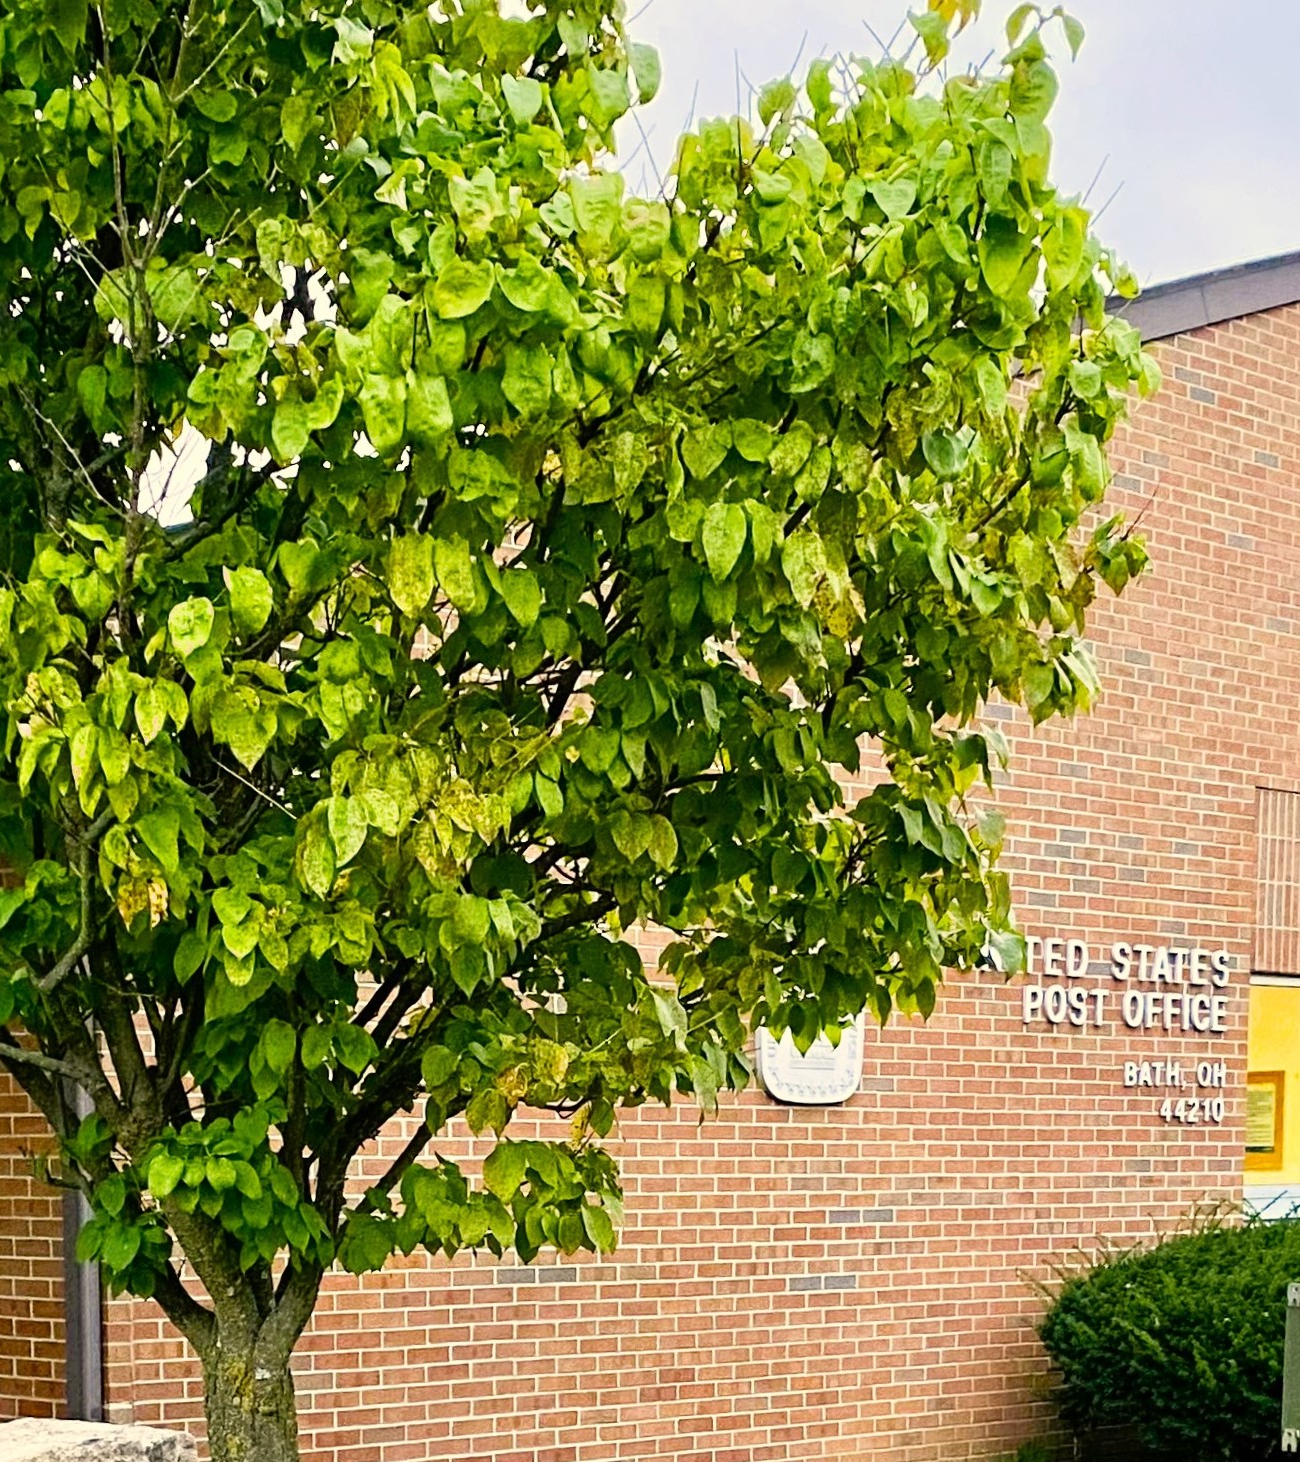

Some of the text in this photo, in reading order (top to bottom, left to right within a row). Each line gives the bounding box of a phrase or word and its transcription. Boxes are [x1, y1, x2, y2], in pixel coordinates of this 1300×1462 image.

[1111, 941, 1230, 988] STATES
[1022, 984, 1229, 1033] POST OFFICE
[1123, 1061, 1227, 1091] BATH, OH
[1159, 1097, 1225, 1124] 44210
